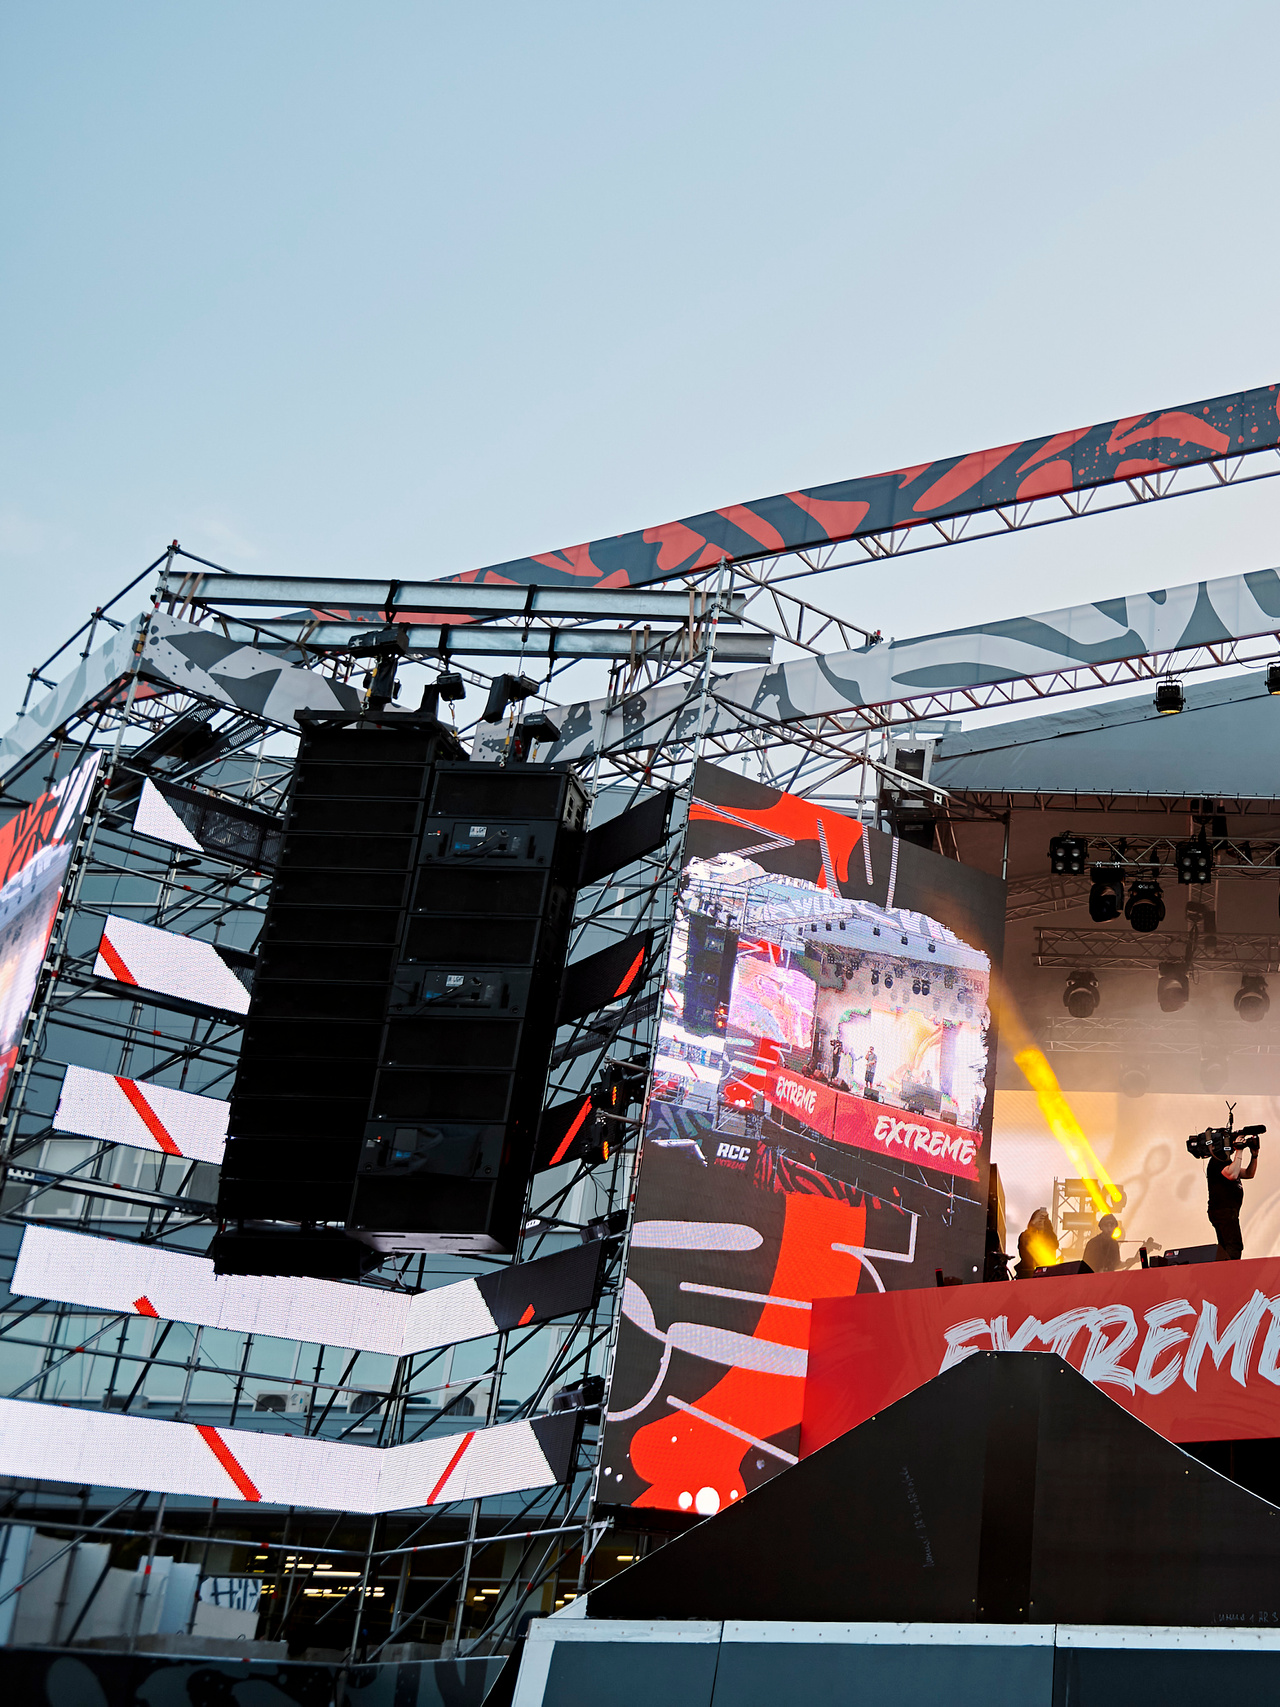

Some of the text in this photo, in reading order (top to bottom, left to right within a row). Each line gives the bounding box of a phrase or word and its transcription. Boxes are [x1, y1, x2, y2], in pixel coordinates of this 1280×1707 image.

[776, 1076, 818, 1114] EXTREME
[716, 1142, 751, 1162] RCC
[873, 1114, 978, 1166] EXTREME
